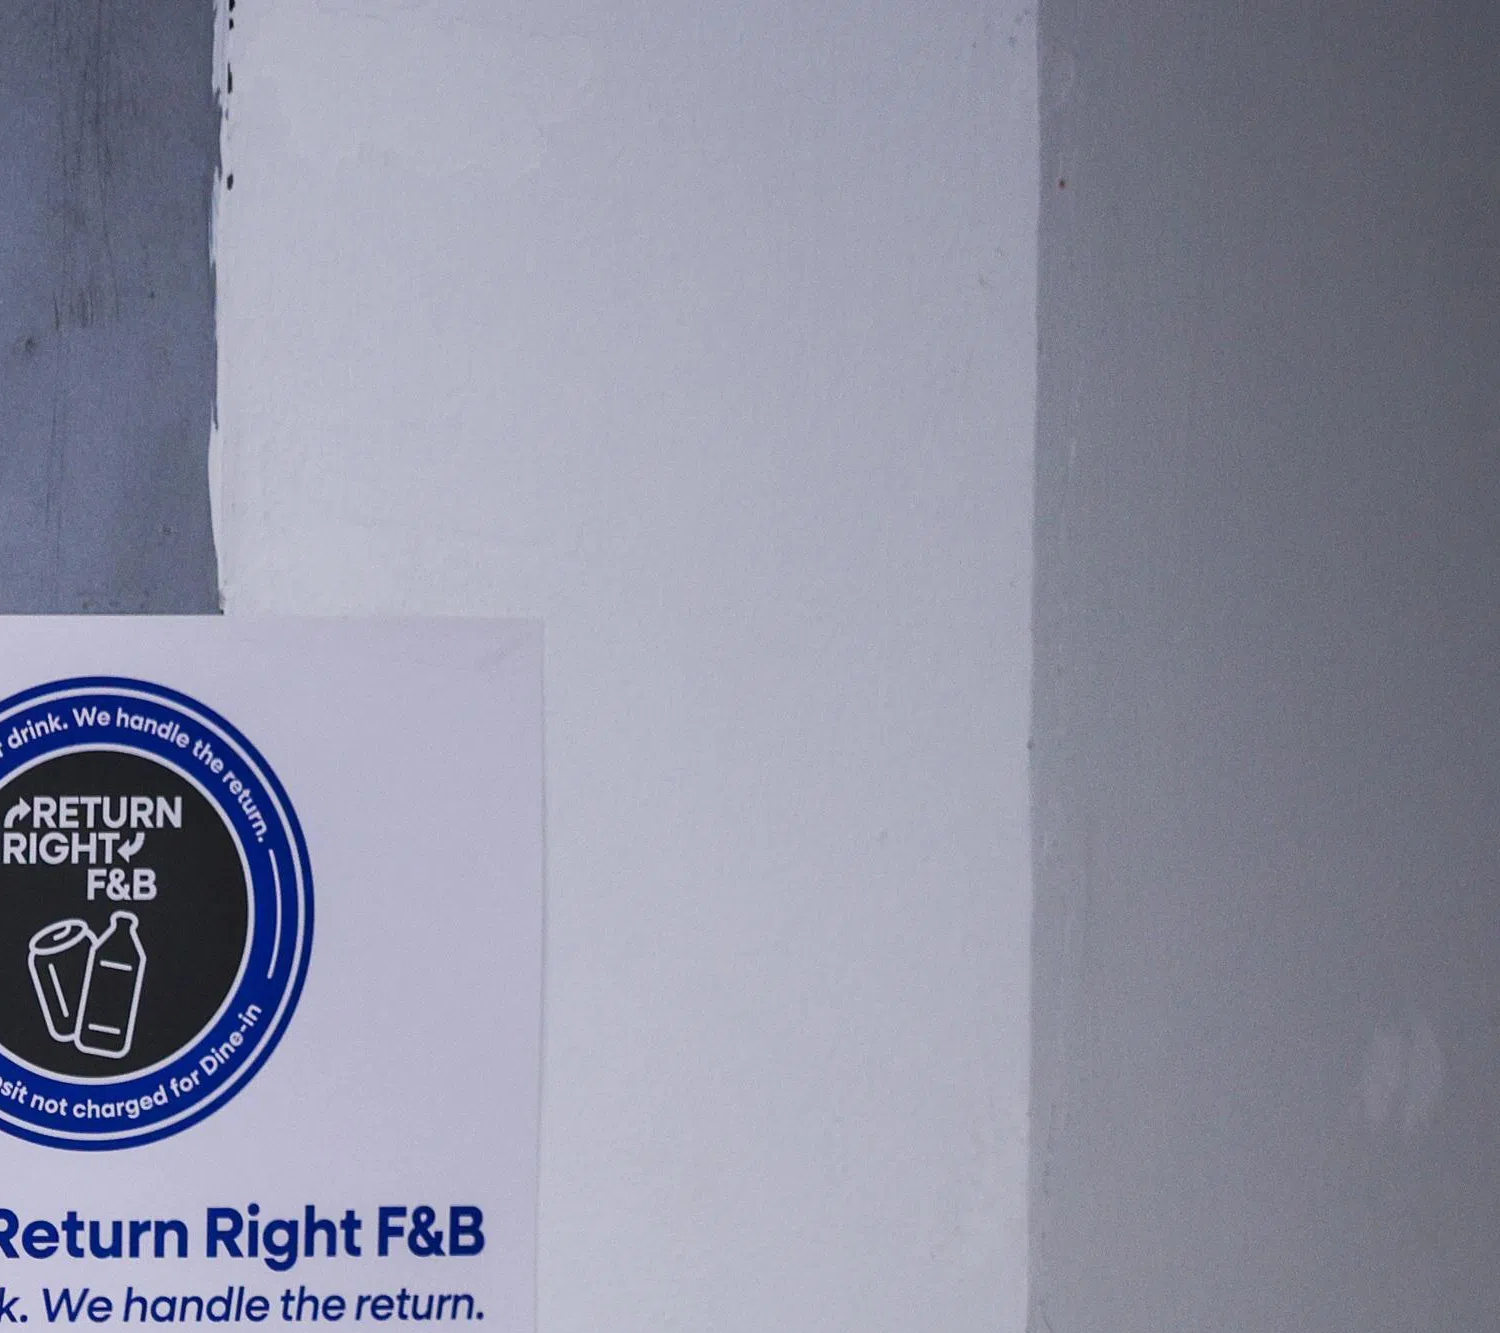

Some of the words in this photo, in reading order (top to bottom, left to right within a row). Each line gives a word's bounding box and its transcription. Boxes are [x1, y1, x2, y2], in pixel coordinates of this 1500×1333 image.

[7, 713, 68, 749] drink.
[72, 706, 110, 728] We
[116, 707, 190, 748] handle
[192, 740, 224, 774] the
[222, 770, 268, 843] return.
[33, 796, 182, 828] RETURN
[3, 832, 120, 865] RIGHT
[87, 868, 157, 901] F&B
[30, 1094, 68, 1116] not
[72, 1084, 169, 1119] charged
[169, 1070, 200, 1098] for
[199, 1003, 262, 1076] Dine-in
[207, 1203, 362, 1271] Right
[378, 1206, 485, 1257] F&B
[43, 1288, 113, 1323] We
[123, 1286, 270, 1322] handle
[281, 1286, 346, 1321] the
[355, 1288, 483, 1321] return.
